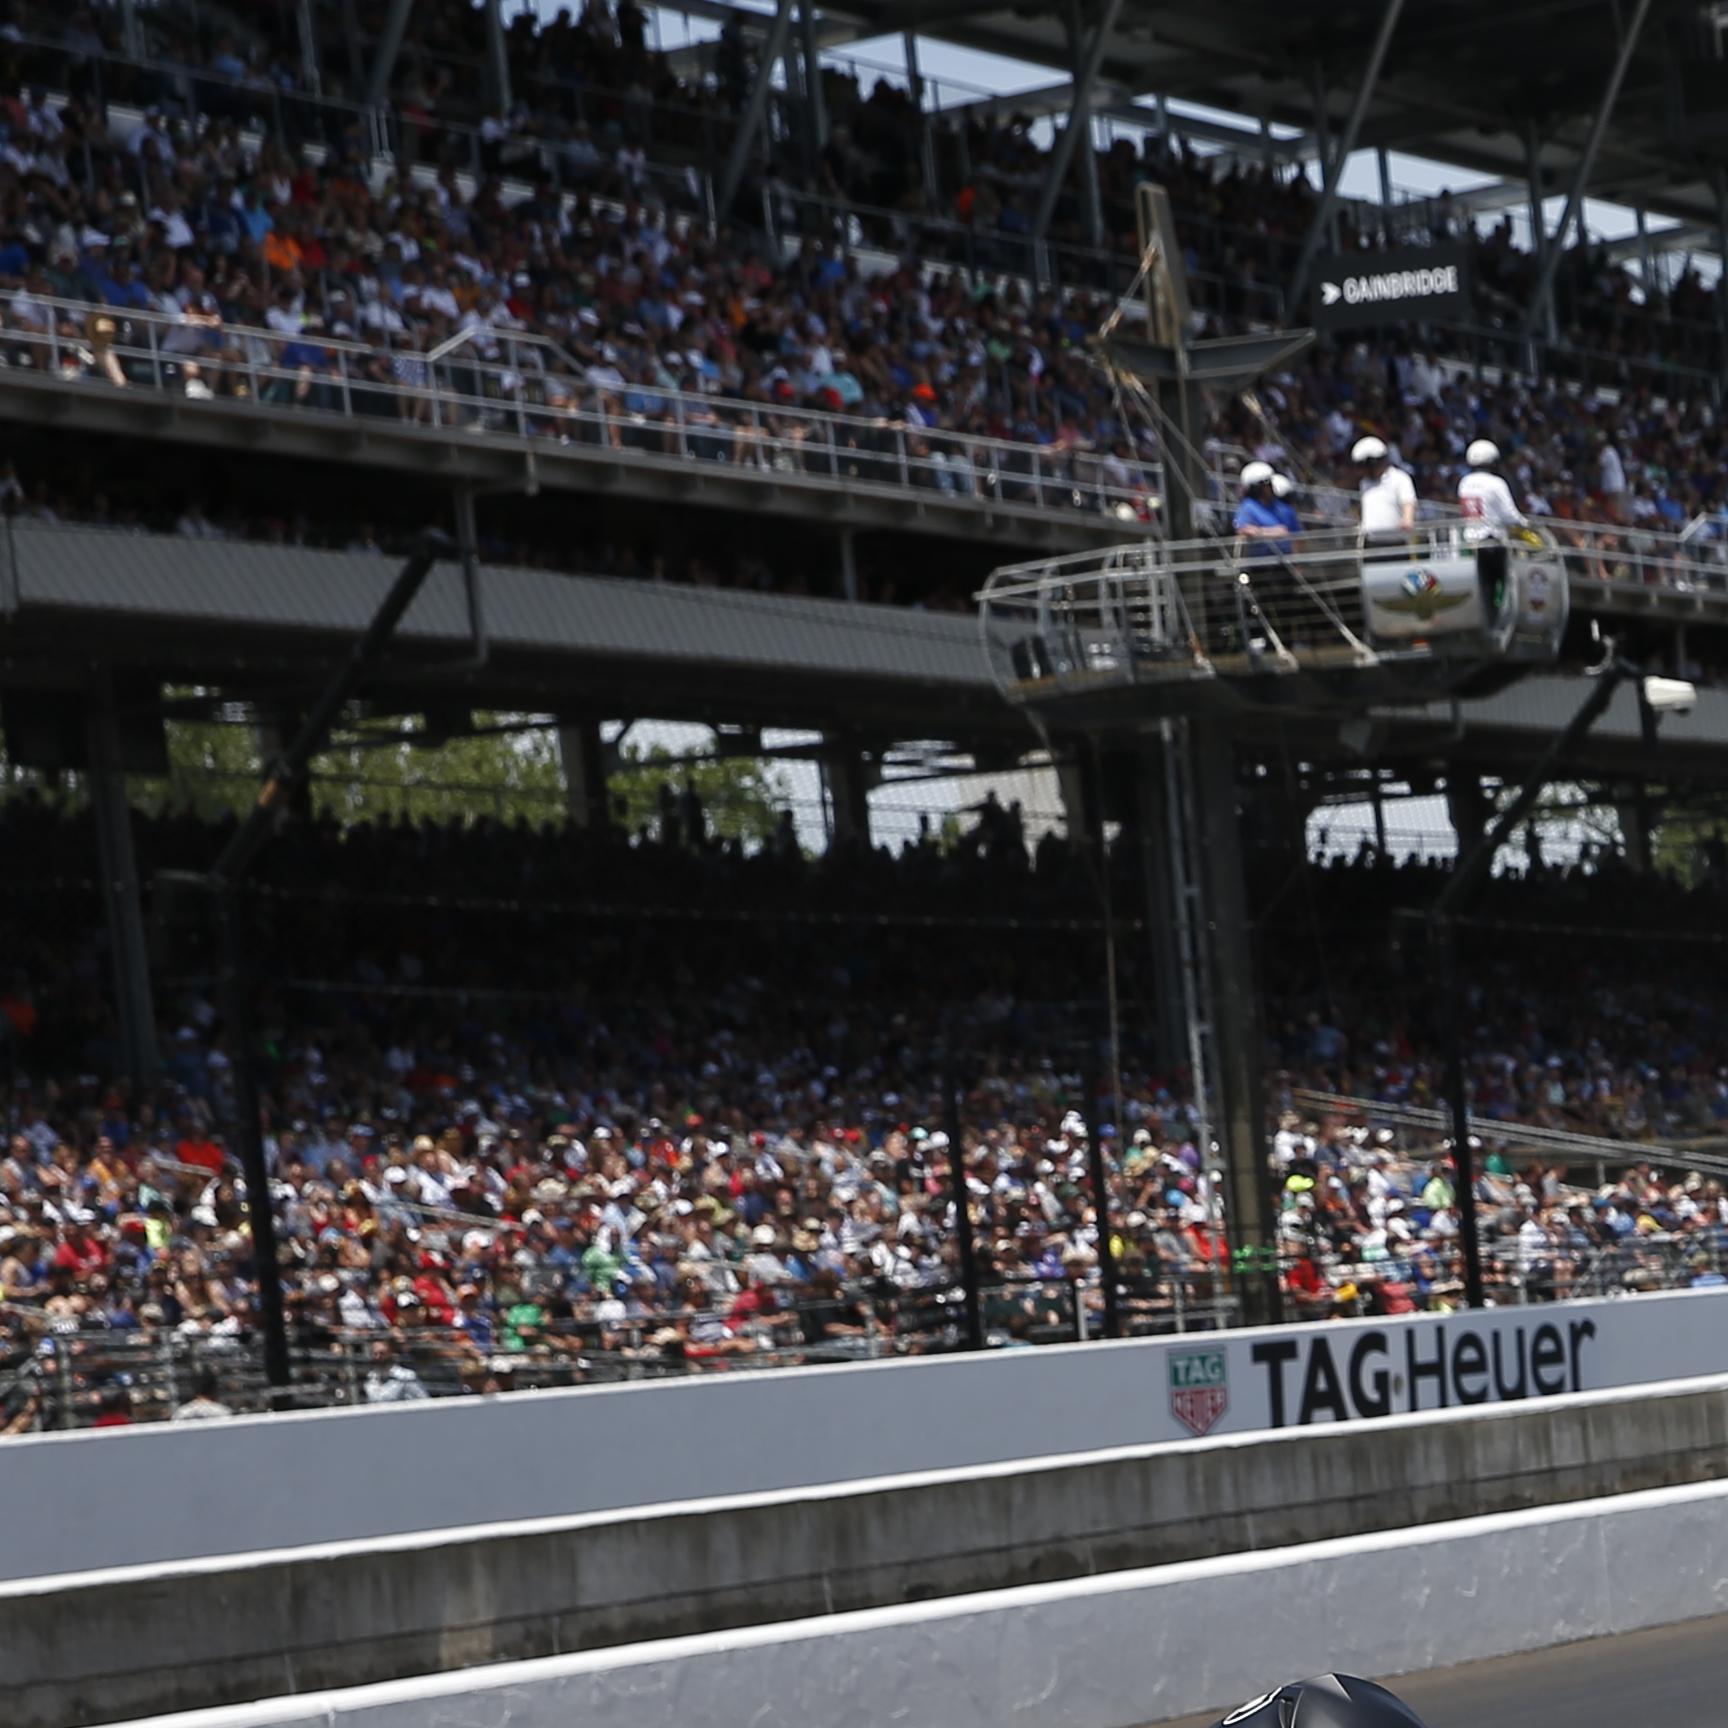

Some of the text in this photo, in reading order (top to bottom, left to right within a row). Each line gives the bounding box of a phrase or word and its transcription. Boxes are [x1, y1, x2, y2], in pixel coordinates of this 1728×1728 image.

[1343, 265, 1458, 304] GAINBRIDGE
[1175, 1353, 1224, 1381] TAG
[1251, 1319, 1596, 1428] TAG Heuer
